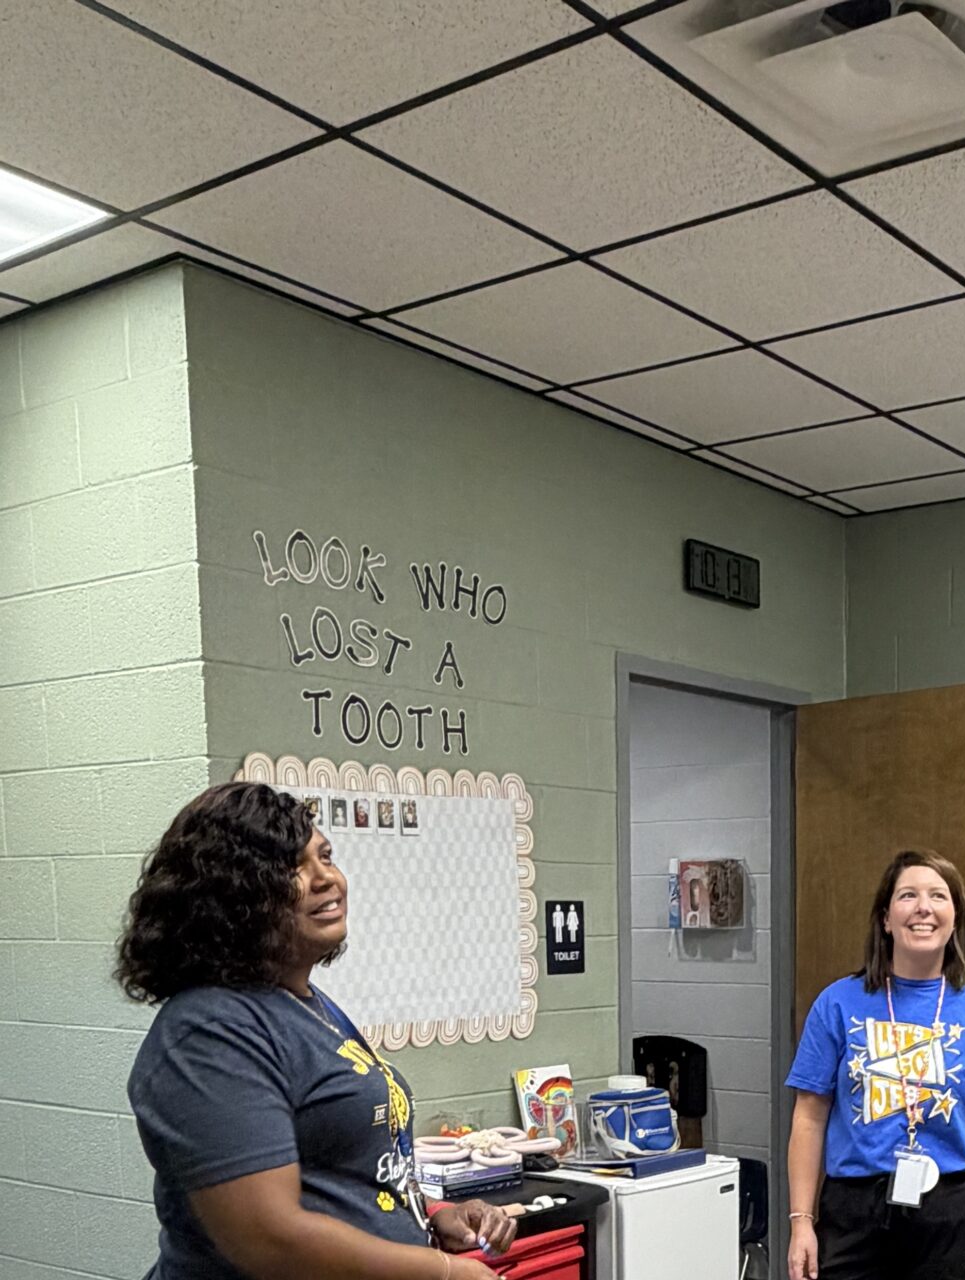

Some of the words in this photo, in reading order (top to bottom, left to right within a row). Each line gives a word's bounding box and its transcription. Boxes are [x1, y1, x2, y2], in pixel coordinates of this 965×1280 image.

[253, 528, 387, 604] LOOK
[409, 562, 507, 625] WHO
[280, 606, 411, 675] LOST
[433, 641, 465, 688] A
[302, 689, 469, 754] TOOTH
[553, 951, 580, 961] TOILET
[897, 1050, 929, 1077] GO
